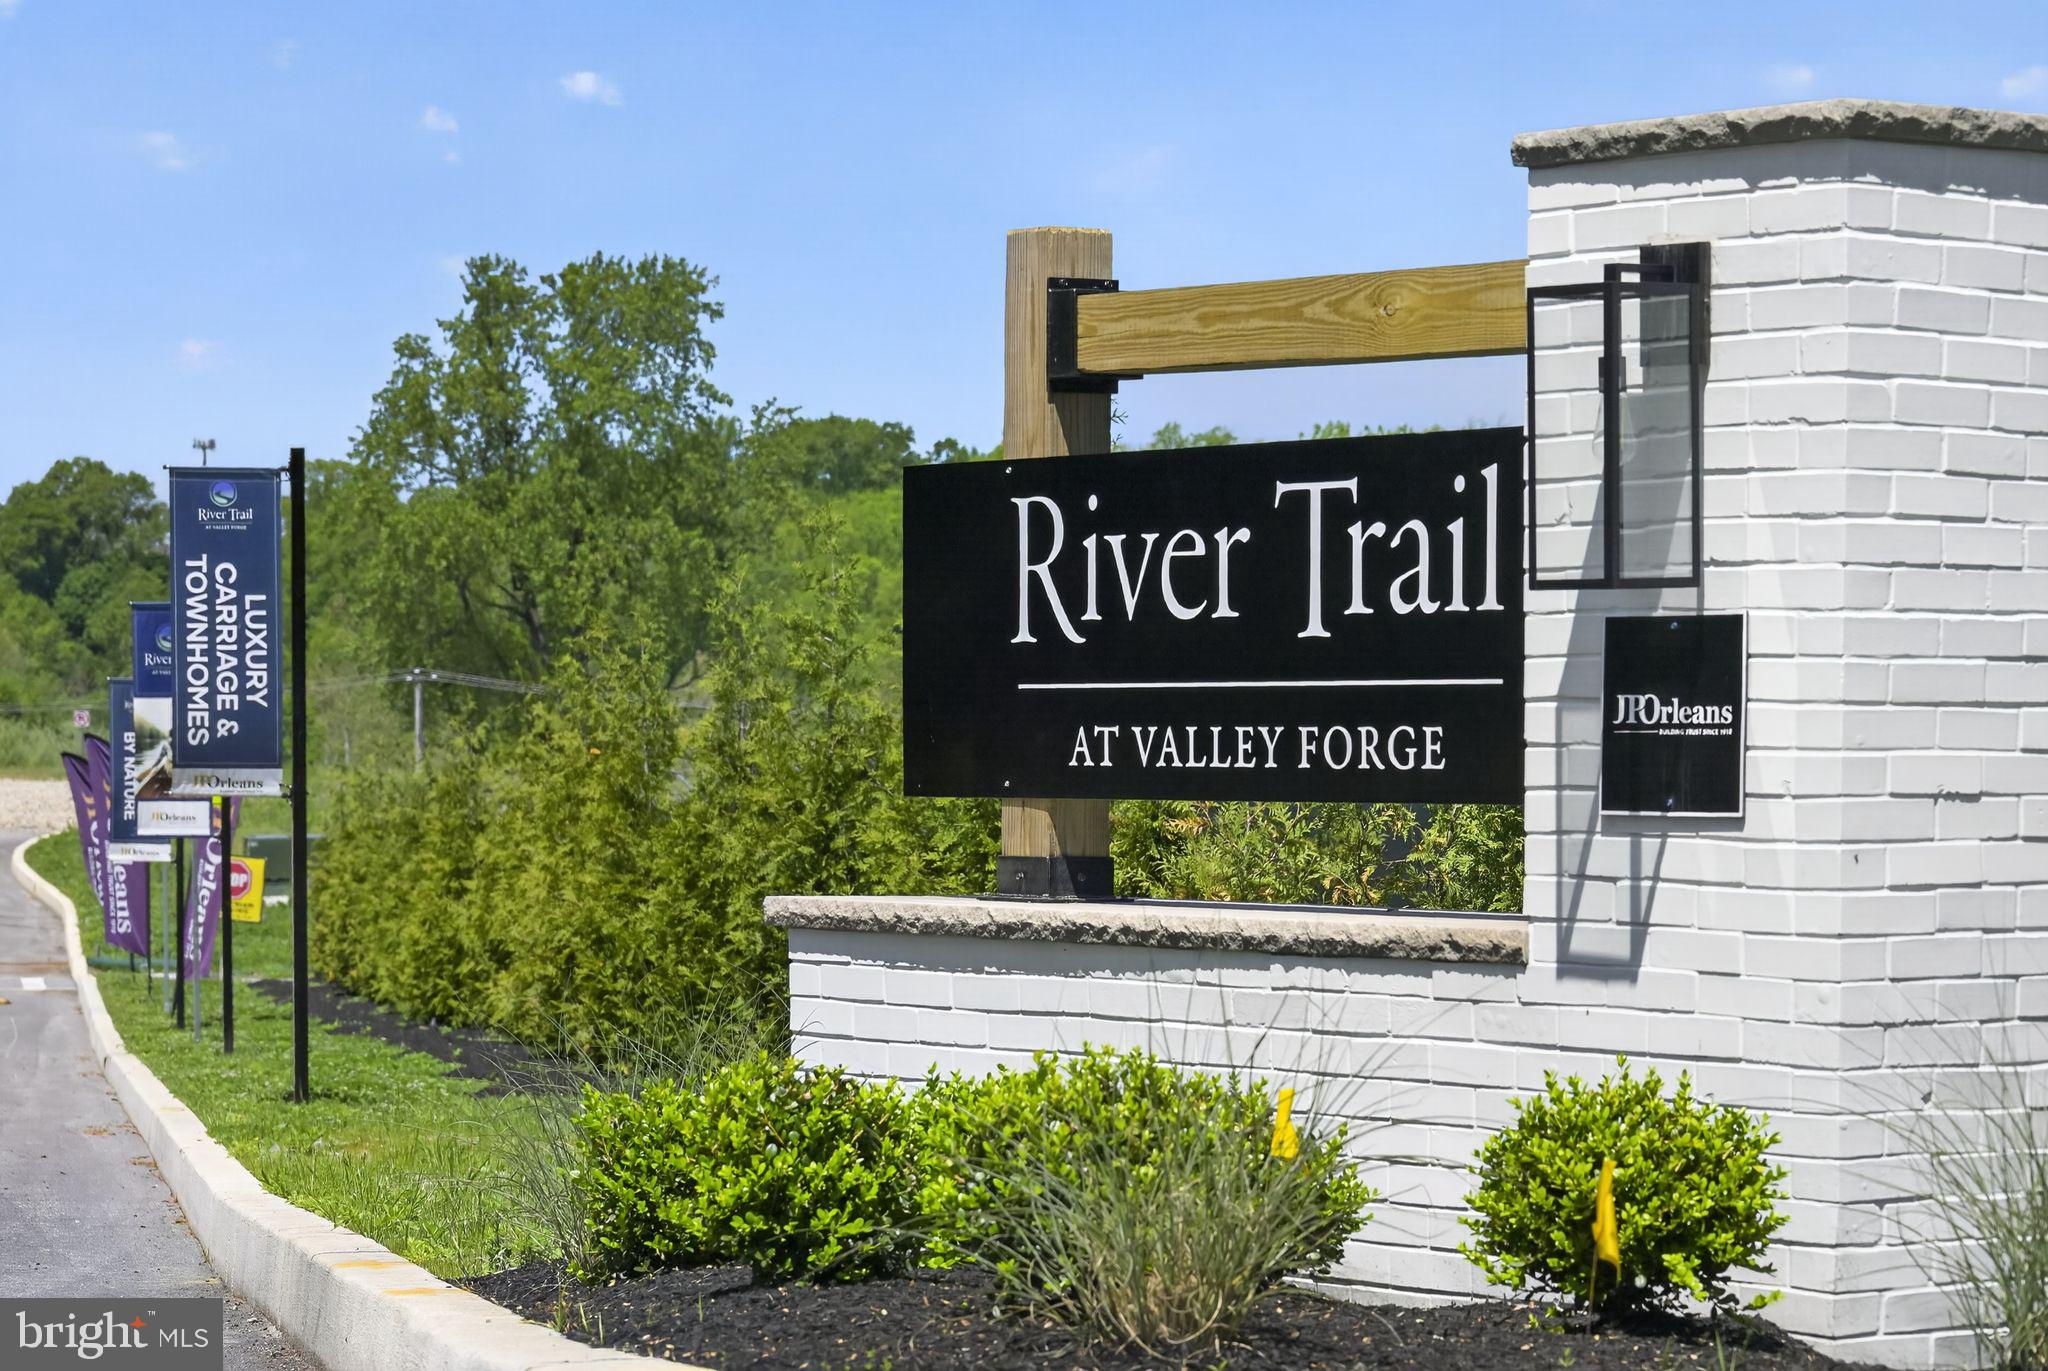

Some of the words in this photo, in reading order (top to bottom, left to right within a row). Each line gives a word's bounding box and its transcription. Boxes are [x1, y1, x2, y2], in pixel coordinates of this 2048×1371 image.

[198, 508, 227, 521] River
[228, 508, 253, 521] Trail
[1010, 494, 1251, 644] River
[1274, 463, 1505, 639] Trail
[185, 554, 210, 746] TOWNHOMES
[214, 562, 239, 711] CARRIAGE
[244, 594, 268, 708] LUXURY
[216, 718, 239, 738] &
[1612, 693, 1733, 725] JPOrleans
[124, 731, 136, 754] BY
[1069, 725, 1119, 768] AT
[1131, 725, 1284, 769] VALLEY
[1298, 725, 1446, 770] FORGE
[1702, 728, 1719, 736] SINCE
[124, 756, 136, 821] NATURE
